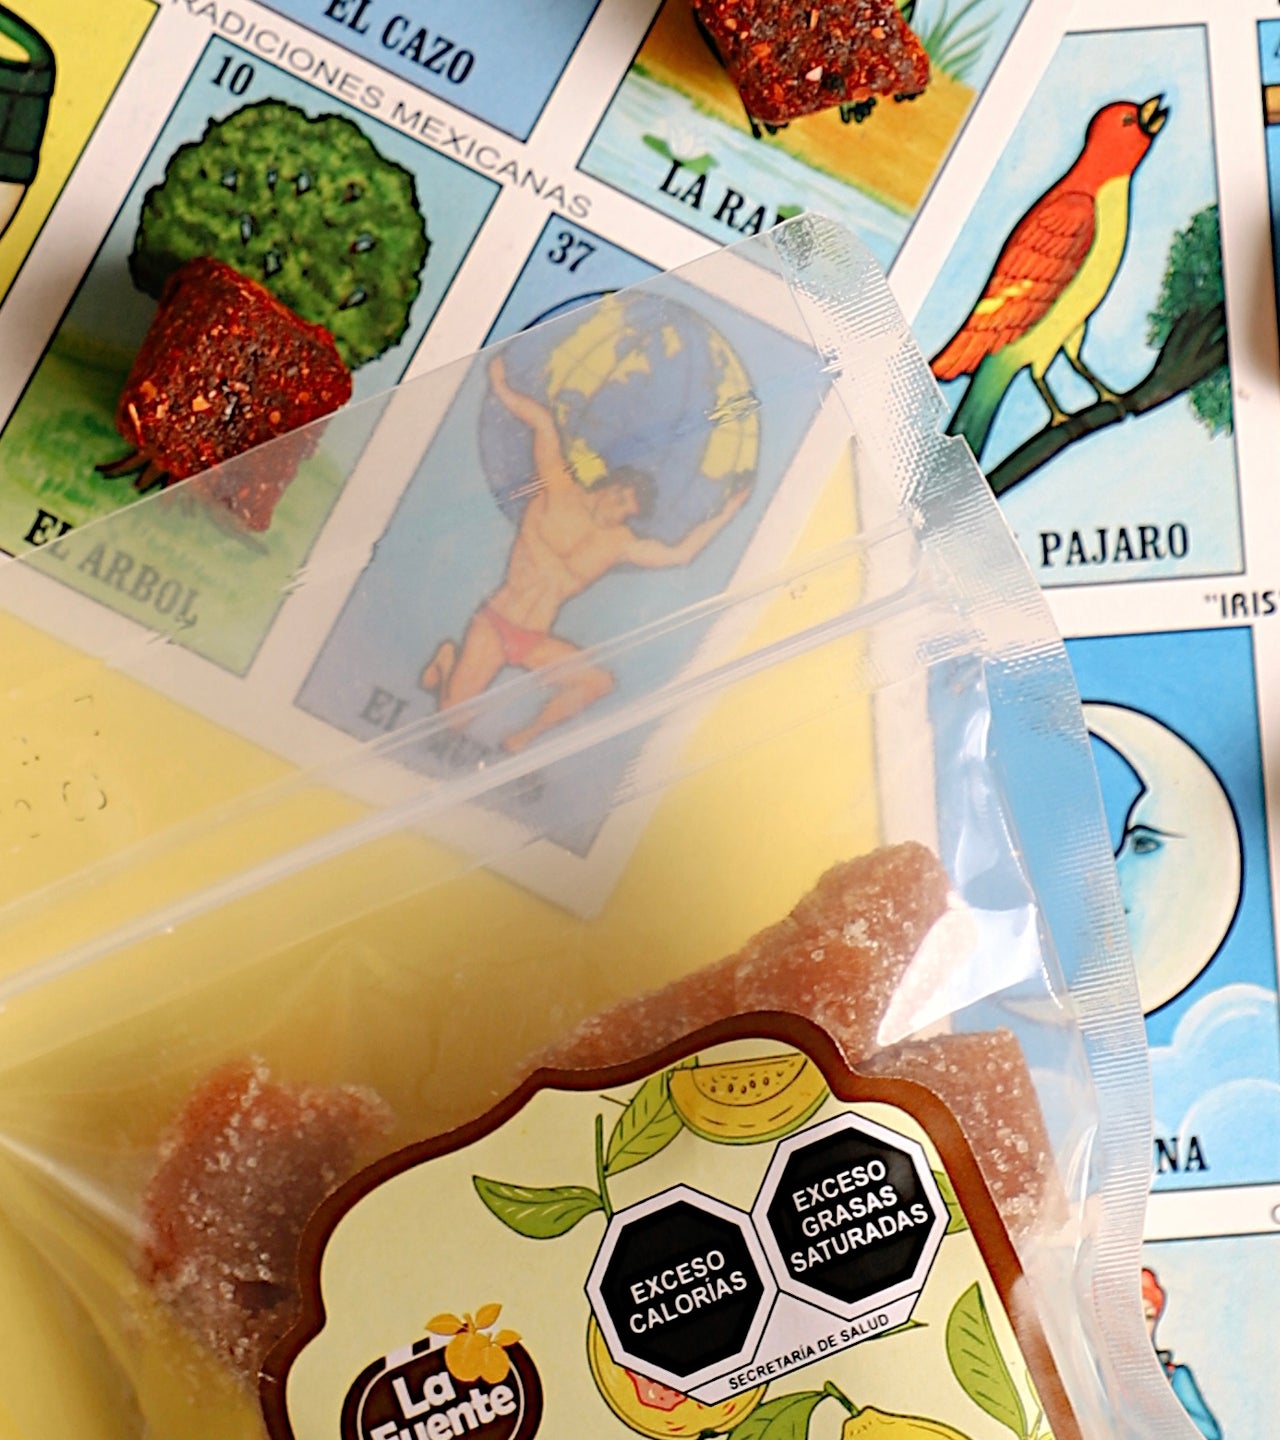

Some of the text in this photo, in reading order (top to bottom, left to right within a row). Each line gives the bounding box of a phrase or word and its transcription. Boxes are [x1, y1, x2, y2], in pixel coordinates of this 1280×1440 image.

[208, 54, 254, 98] 10
[378, 15, 476, 86] CAZO
[388, 98, 593, 218] MEXICANAS
[659, 160, 708, 209] LA
[547, 231, 595, 273] 37
[1040, 524, 1191, 567] PAJARO
[792, 1159, 886, 1214] EXCESO
[801, 1186, 898, 1238] GRASAS
[790, 1202, 929, 1274] SATURADAS
[629, 1250, 726, 1305] EXCESO
[629, 1269, 748, 1336] CALORÍAS
[817, 1312, 890, 1352] DE SALUD
[394, 1376, 456, 1421] La
